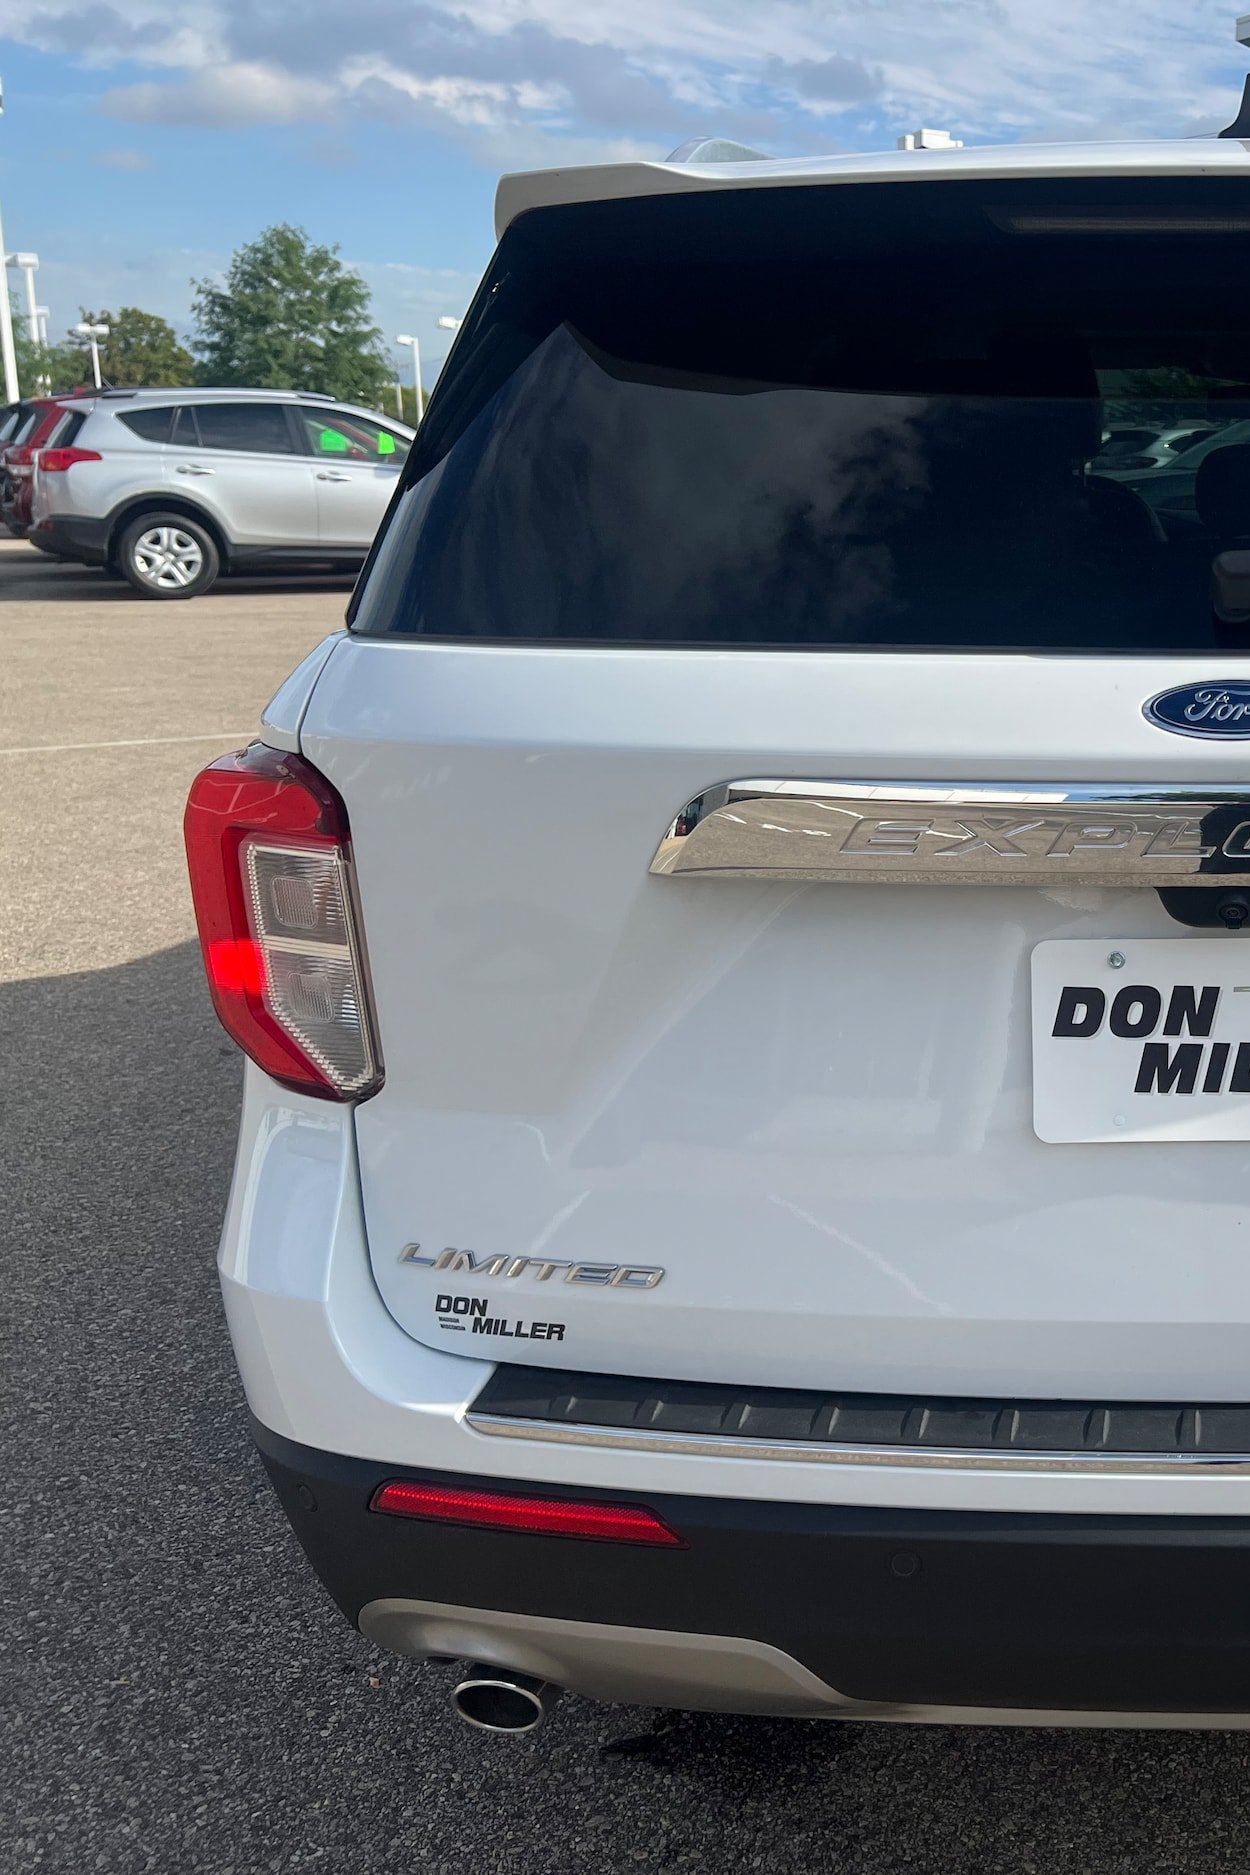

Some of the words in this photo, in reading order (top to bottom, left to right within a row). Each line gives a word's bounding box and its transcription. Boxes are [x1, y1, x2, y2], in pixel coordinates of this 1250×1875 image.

[1052, 985, 1221, 1038] DON
[399, 1242, 665, 1288] LIMITED
[435, 1294, 488, 1317] DON
[472, 1317, 566, 1341] MILLER
